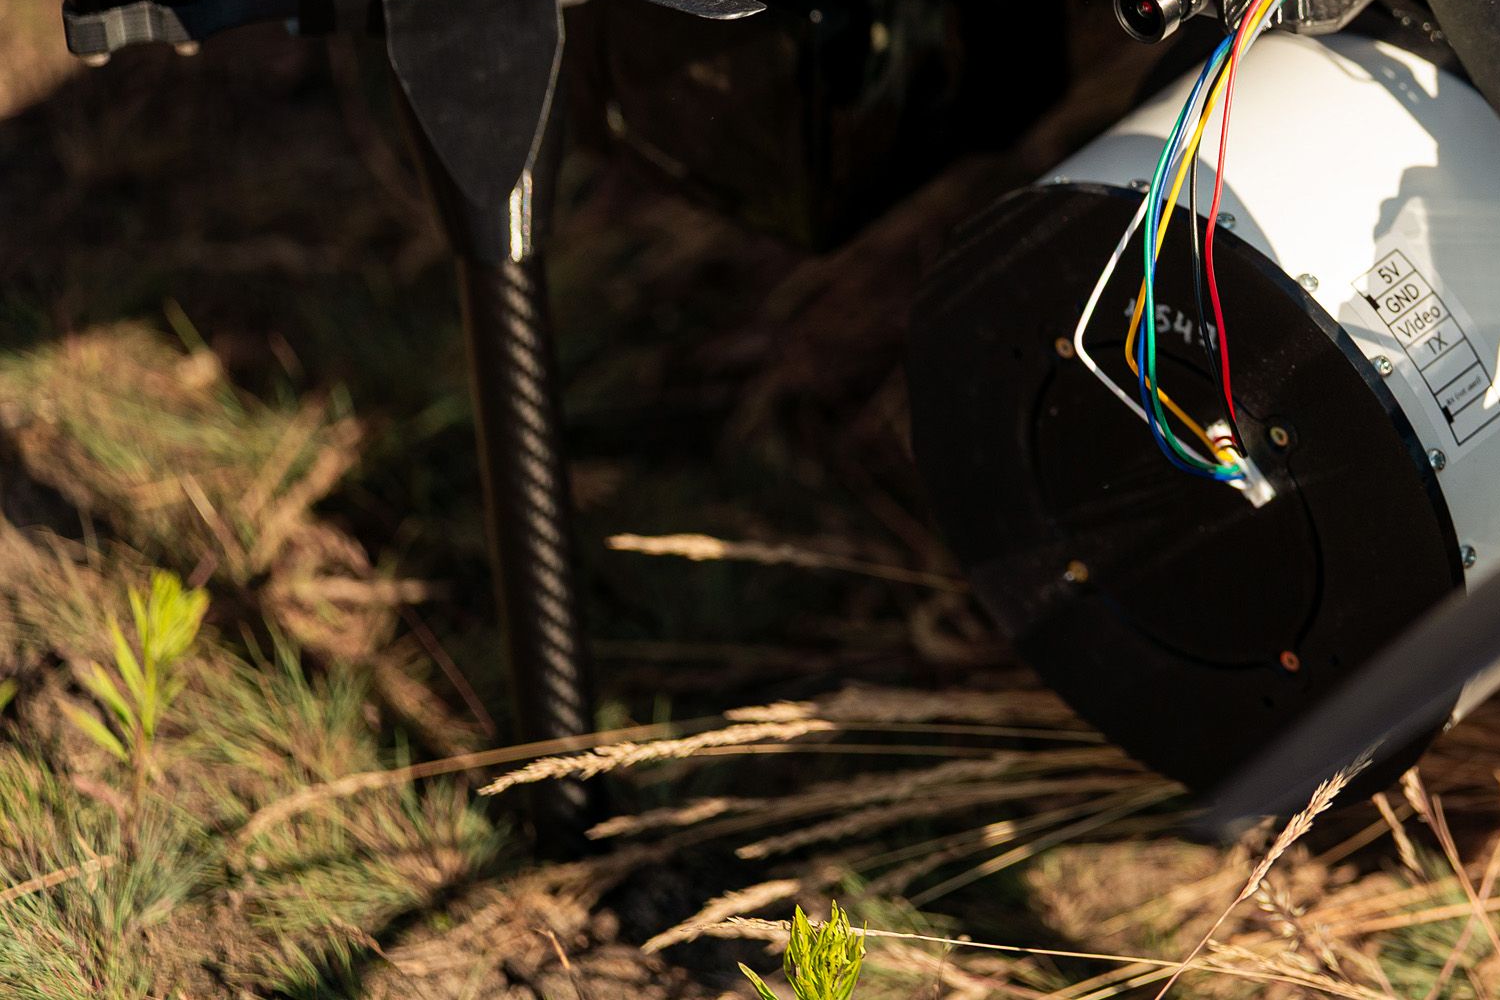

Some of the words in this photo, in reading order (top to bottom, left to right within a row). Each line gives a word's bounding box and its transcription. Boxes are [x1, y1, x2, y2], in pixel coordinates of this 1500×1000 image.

[1377, 262, 1400, 285] 5V
[1385, 283, 1420, 314] GND
[1397, 305, 1441, 339] Video
[1423, 332, 1448, 355] TX
